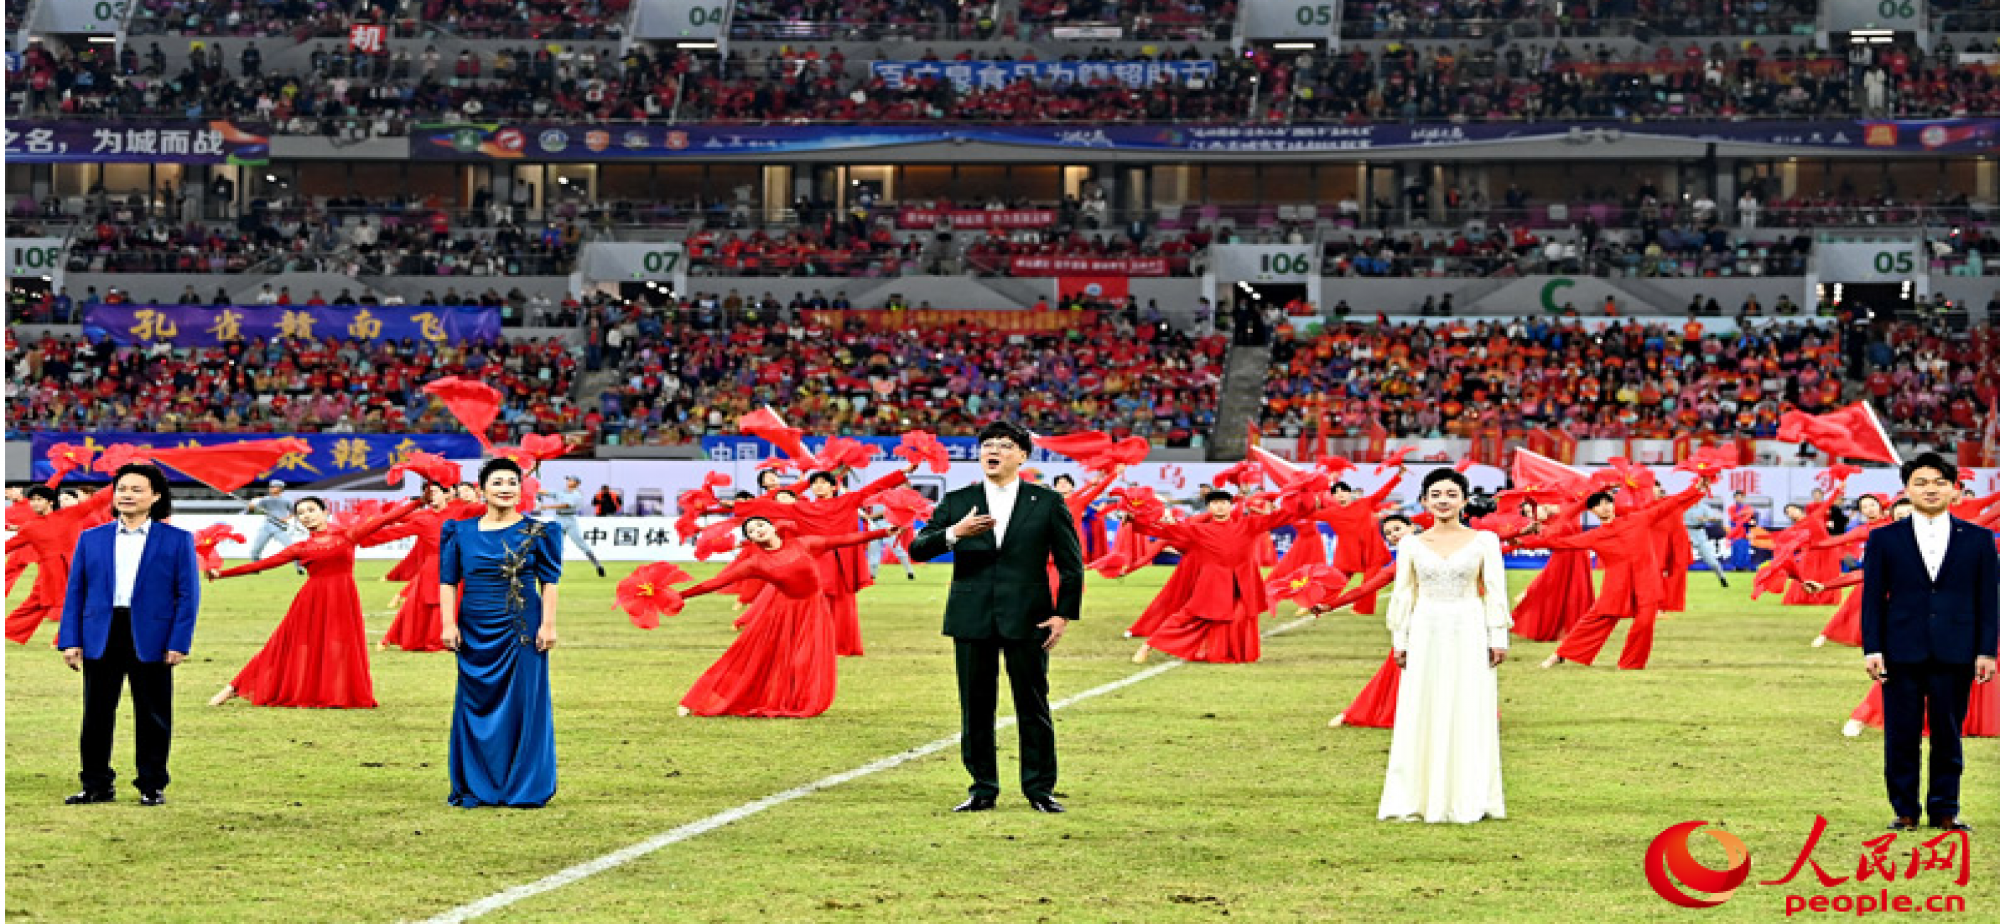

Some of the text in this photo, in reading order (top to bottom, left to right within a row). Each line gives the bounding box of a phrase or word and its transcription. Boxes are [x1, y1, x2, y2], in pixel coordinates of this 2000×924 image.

[690, 6, 723, 27] 04
[1296, 5, 1331, 27] 05
[1878, 0, 1915, 19] 06
[352, 26, 381, 52] 机
[644, 251, 679, 273] 07
[1261, 252, 1309, 275] 106
[1875, 251, 1912, 274] 05
